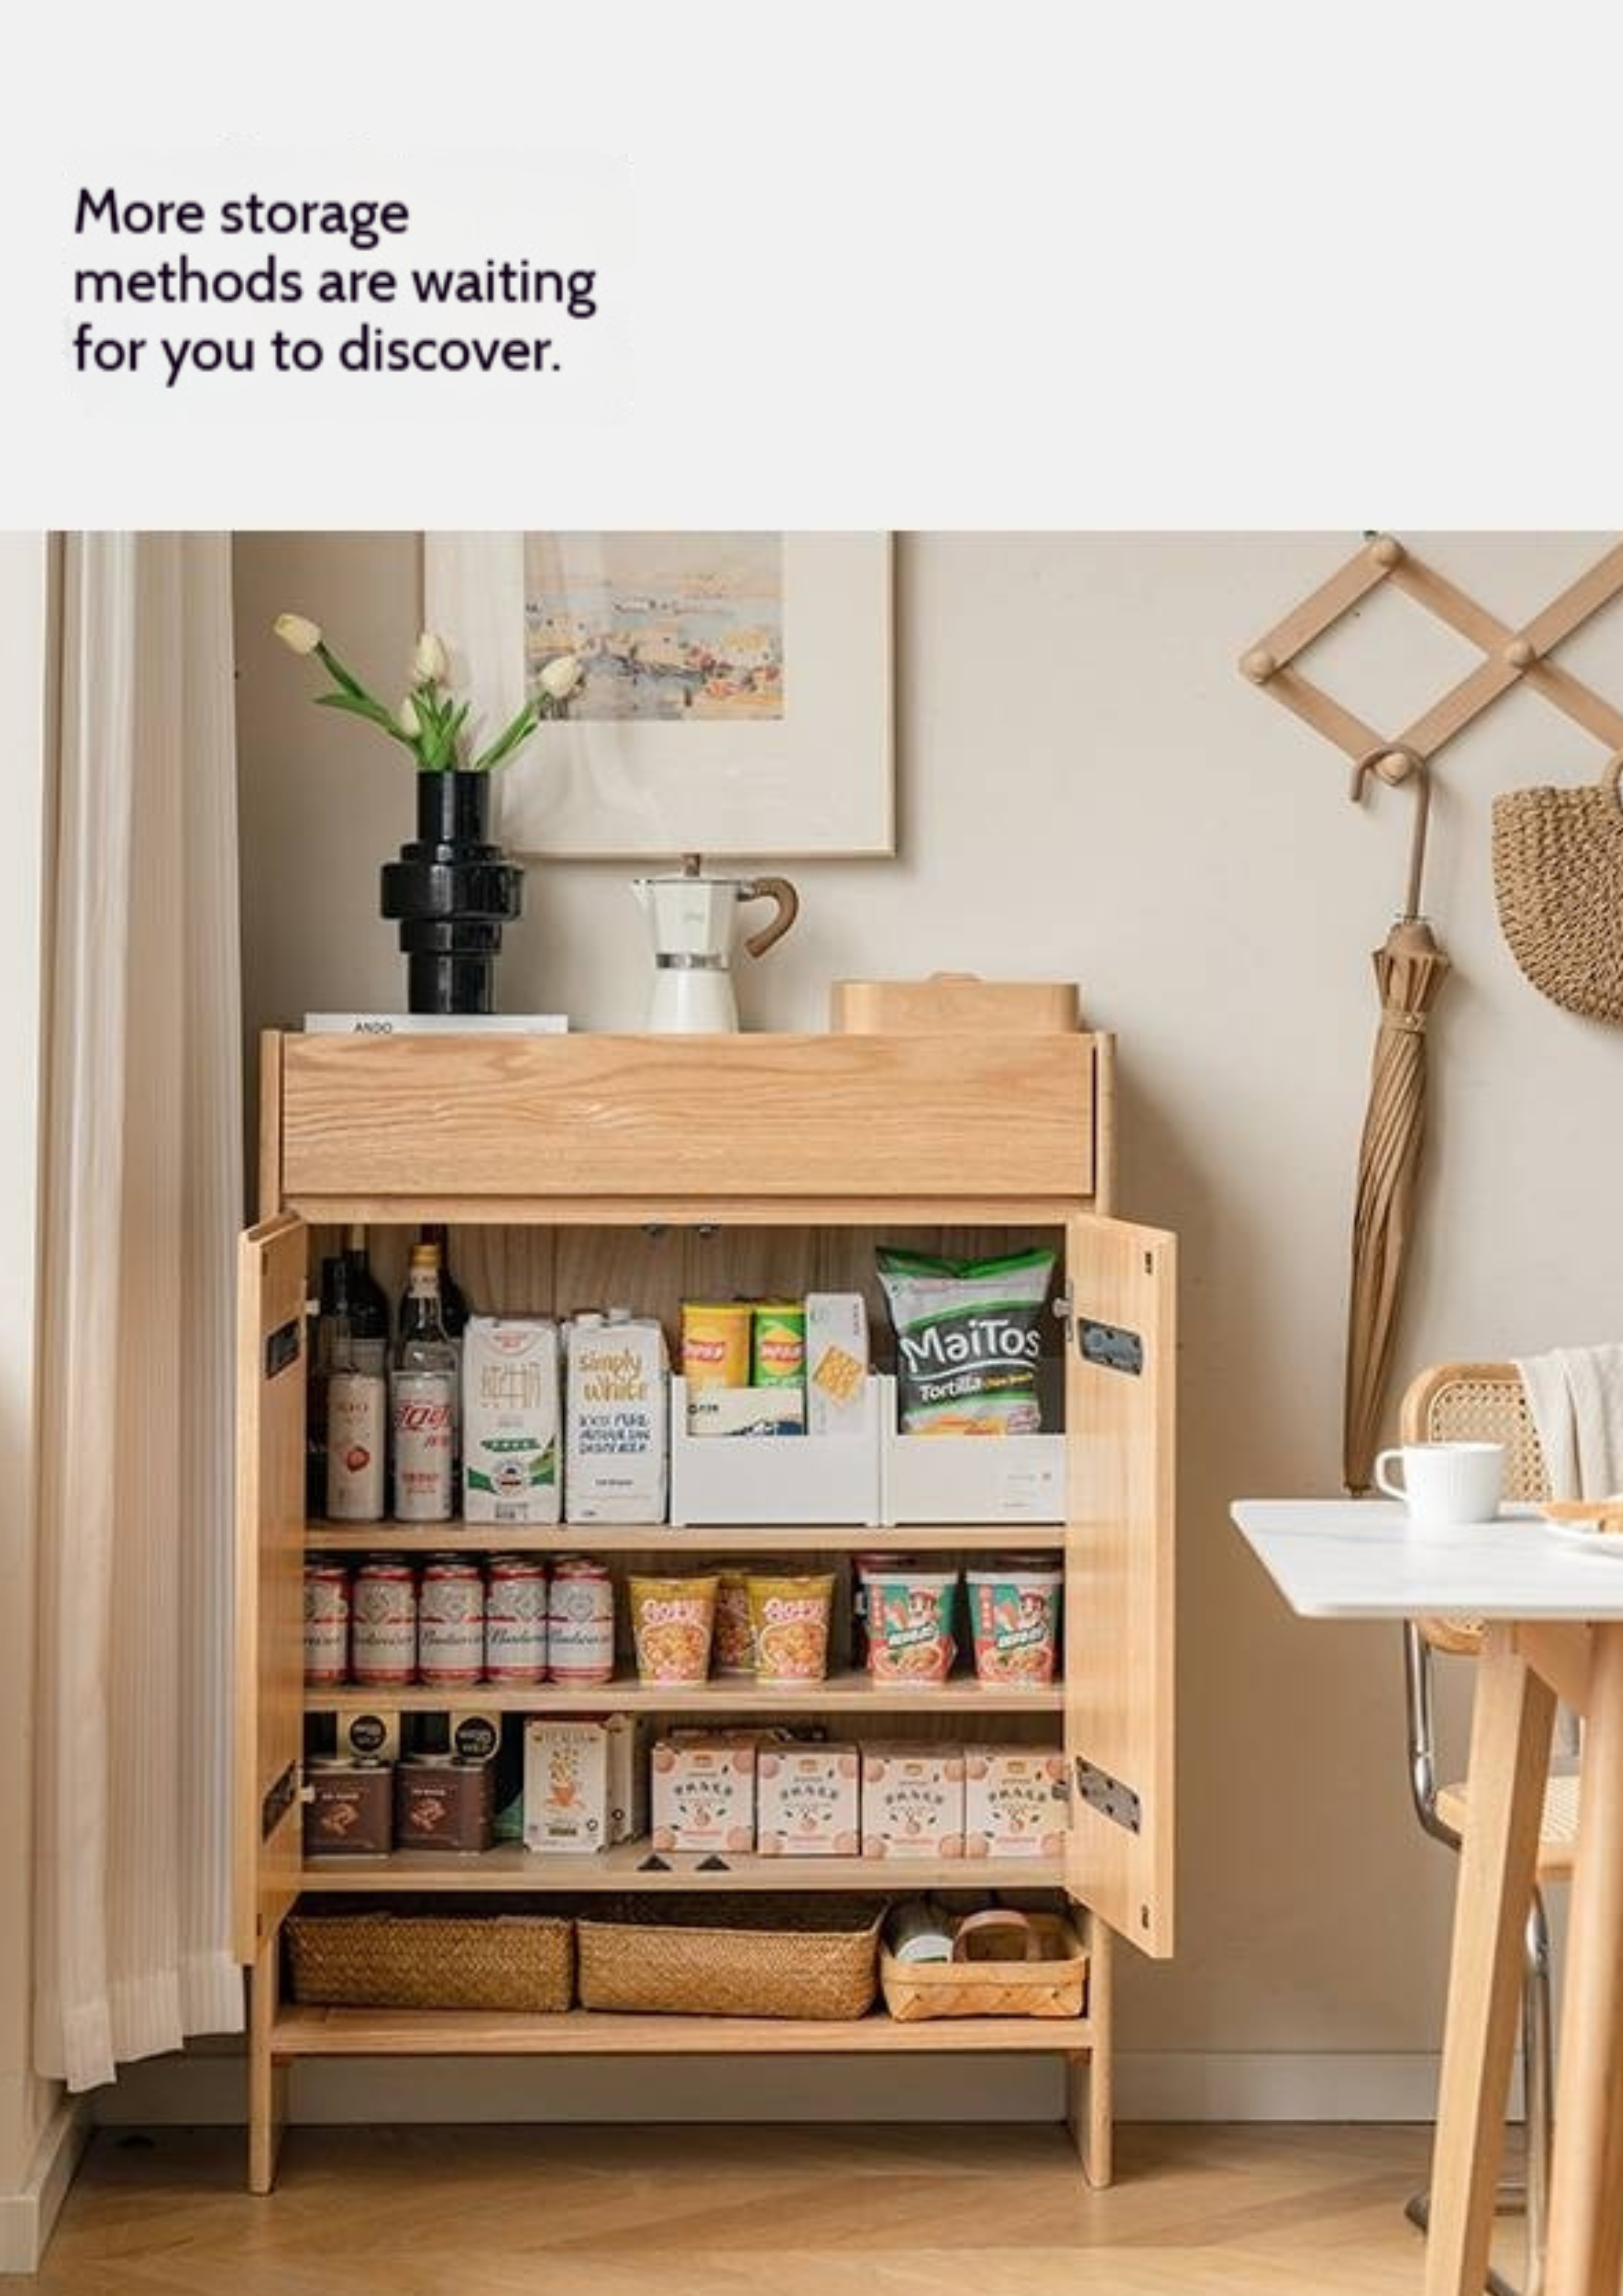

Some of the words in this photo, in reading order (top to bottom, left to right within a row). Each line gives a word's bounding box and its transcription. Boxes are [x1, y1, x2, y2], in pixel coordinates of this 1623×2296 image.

[353, 1021, 393, 1034] ANDO
[900, 1320, 1040, 1374] MaiTos
[919, 1371, 982, 1402] Tortilla
